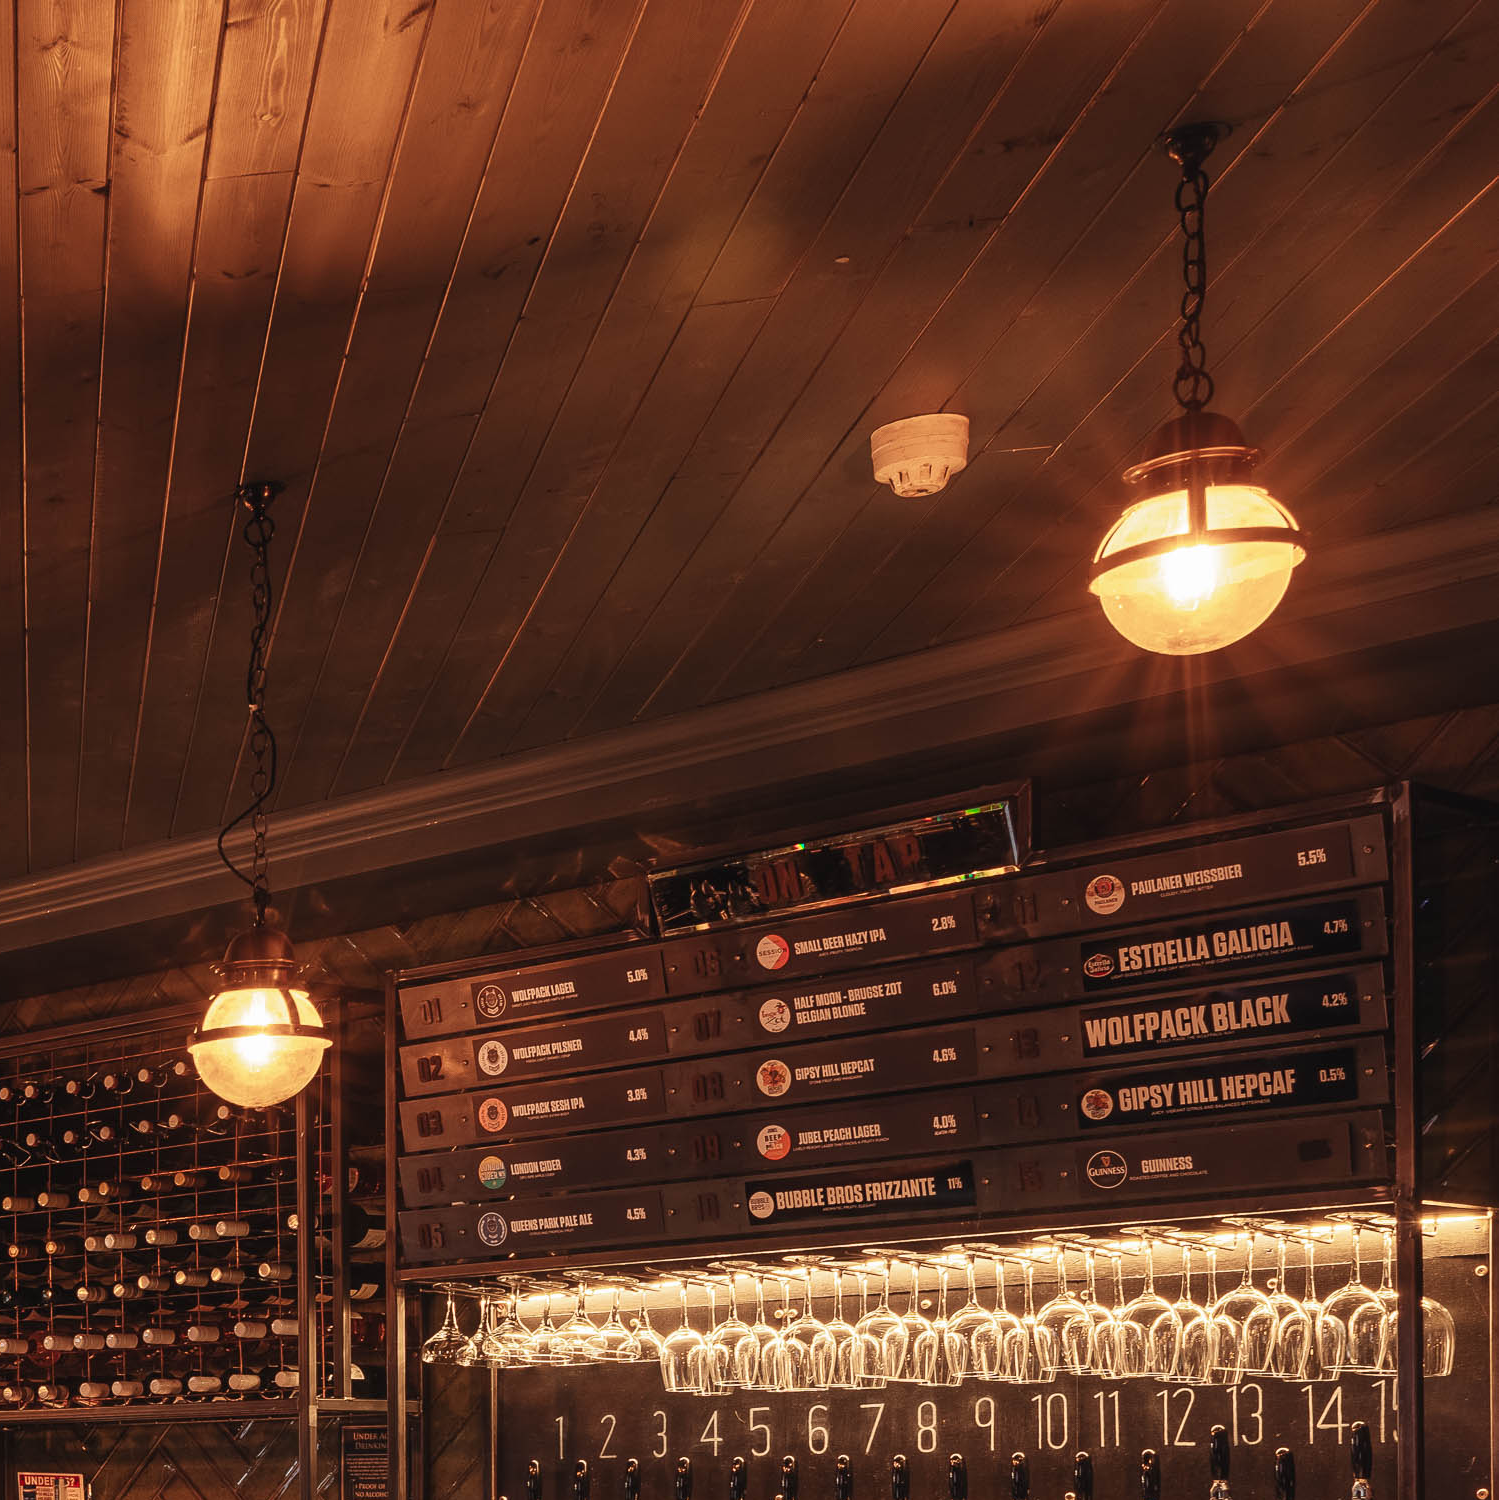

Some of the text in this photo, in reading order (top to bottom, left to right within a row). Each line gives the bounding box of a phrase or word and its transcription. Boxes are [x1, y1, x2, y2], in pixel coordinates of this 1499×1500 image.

[1297, 848, 1327, 867] 5.5%
[1131, 874, 1183, 896] PAULANER
[1183, 864, 1243, 888] WEISSBIER
[931, 916, 956, 931] 2.8%
[1323, 919, 1349, 935] 4.7%
[794, 940, 822, 955] SMALL
[823, 936, 844, 949] BEER
[845, 932, 869, 946] HAZY
[870, 928, 886, 942] IPA
[1118, 936, 1209, 972] ESTRELLA
[1212, 921, 1294, 956] GALICIA
[758, 947, 787, 957] SESSION
[627, 969, 648, 982] 5.0%
[512, 985, 551, 1003] WOLFPACK
[552, 981, 575, 996] LAGER
[794, 996, 815, 1009] HALF
[816, 992, 842, 1007] MOON
[848, 985, 885, 1002] BRUGSE
[885, 982, 903, 996] ZOT
[932, 981, 957, 996] 6.0%
[1322, 992, 1348, 1008] 4.2%
[796, 1008, 830, 1024] BELGIAN
[831, 1003, 866, 1019] BLONDE
[1084, 994, 1291, 1048] WOLFPACK BLACK
[629, 1028, 649, 1042] 4.4%
[513, 1044, 551, 1060] WOLFPACK
[552, 1039, 583, 1053] PILSNER
[933, 1048, 957, 1063] 4.6%
[417, 1055, 444, 1083] 02
[795, 1066, 821, 1080] GIPSY
[822, 1063, 840, 1076] HILL
[841, 1058, 875, 1074] HEPCAT
[1319, 1068, 1346, 1083] 0.5%
[627, 1088, 647, 1101] 3.8%
[1118, 1088, 1175, 1112] GIPSY
[1179, 1080, 1217, 1107] HILL
[1220, 1069, 1297, 1099] HEPCAF
[512, 1102, 551, 1118] WOLFPACK
[551, 1099, 570, 1112] SESH
[571, 1096, 585, 1109] IPA
[417, 1110, 443, 1138] 03
[933, 1115, 956, 1129] 4.0%
[798, 1131, 823, 1145] JUBEL
[823, 1127, 852, 1142] PEACH
[853, 1124, 881, 1139] LAGER
[626, 1148, 646, 1161] 4.3%
[510, 1159, 561, 1175] LONDON CIDER
[1088, 1165, 1126, 1177] GUINNESS
[1141, 1156, 1193, 1173] GUINNESS
[776, 1177, 937, 1210] BUBBLE BROS FRIZZANTE
[511, 1219, 538, 1233] QUEENS
[539, 1218, 558, 1229] PARK
[559, 1216, 577, 1227] PALE
[578, 1213, 593, 1225] ALE
[626, 1208, 646, 1221] 4.5%
[555, 1416, 564, 1460] 1
[599, 1414, 617, 1459] 2
[652, 1410, 668, 1458] 3
[699, 1410, 723, 1457] 4
[748, 1406, 771, 1456] 5
[808, 1404, 829, 1455] 6
[859, 1403, 885, 1455] 7
[917, 1401, 937, 1453] 8
[974, 1396, 995, 1452] 9
[1031, 1392, 1069, 1450] 10
[1093, 1390, 1121, 1448] 11
[1156, 1388, 1197, 1447] 12
[1226, 1383, 1263, 1447] 13
[1300, 1385, 1350, 1445] 14
[354, 1440, 387, 1449] DRINKIN
